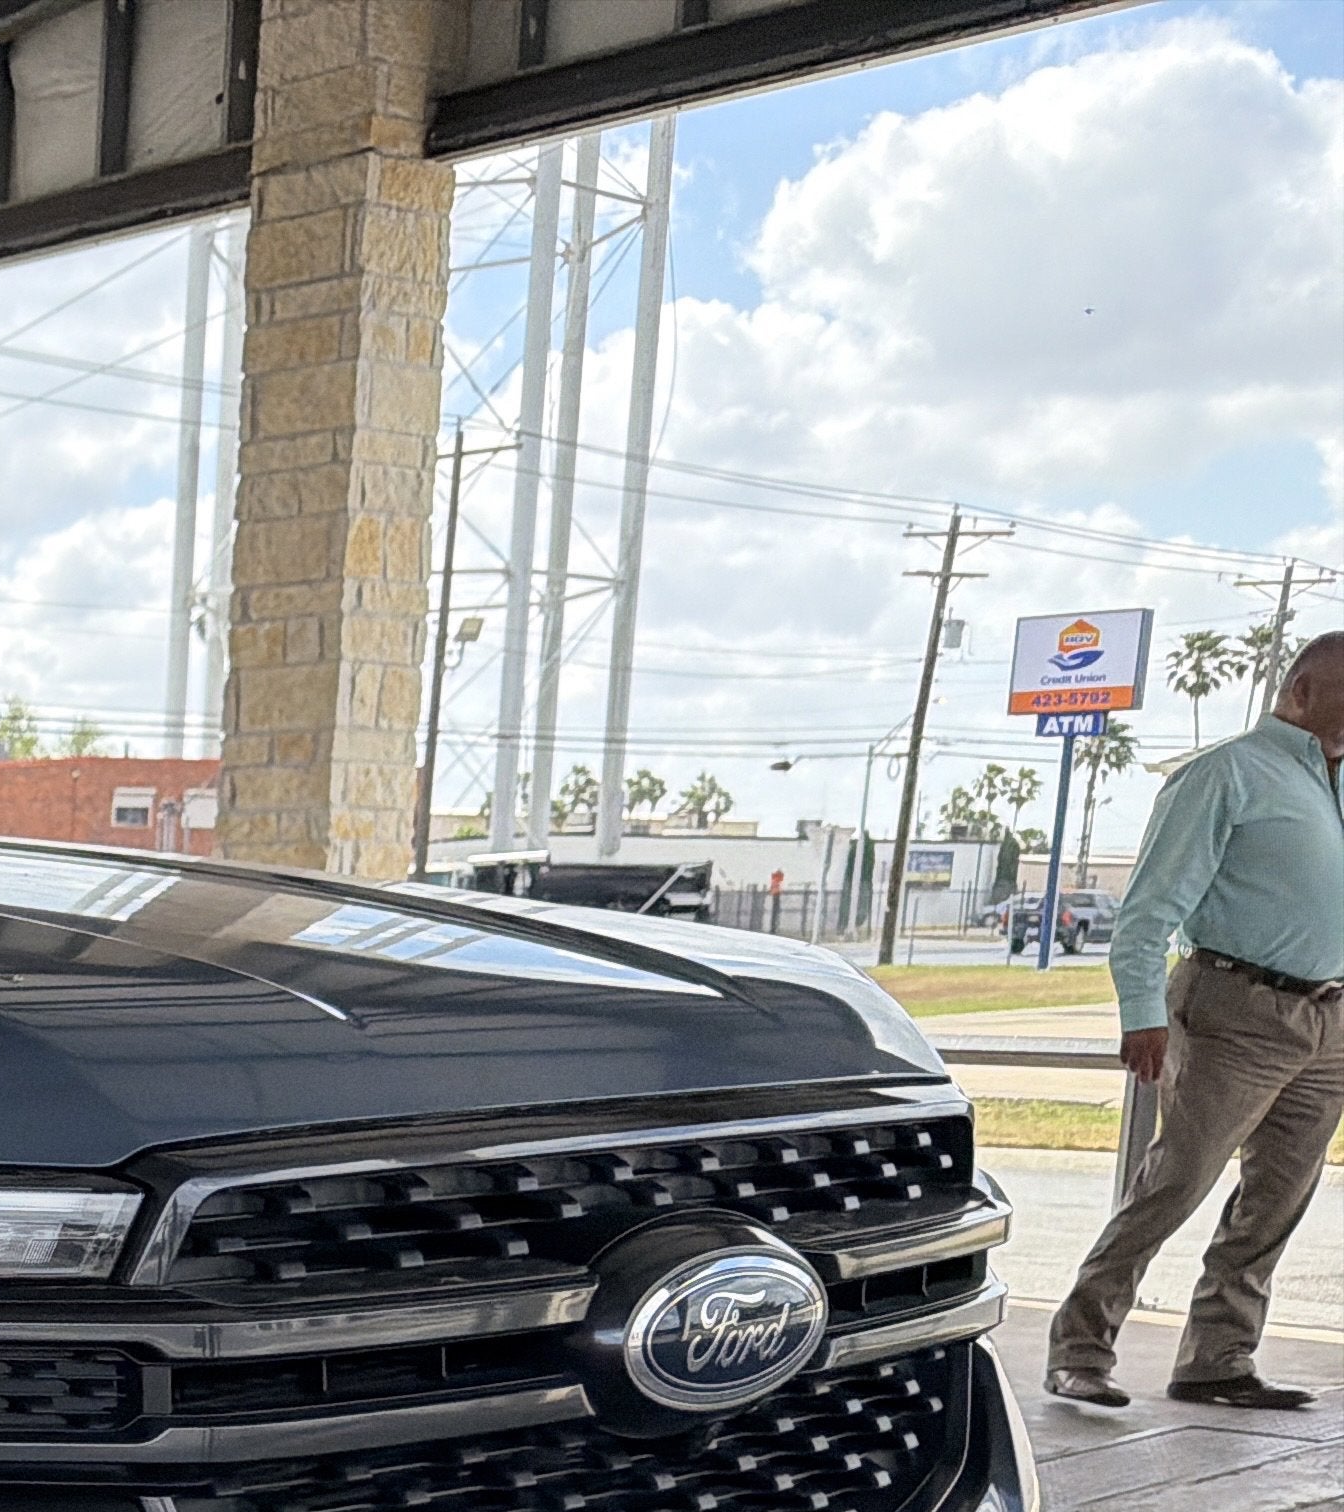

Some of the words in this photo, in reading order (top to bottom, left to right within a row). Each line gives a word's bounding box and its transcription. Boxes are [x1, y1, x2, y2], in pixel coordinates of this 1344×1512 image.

[1040, 675, 1072, 685] Credit
[1075, 673, 1107, 684] Union
[1043, 714, 1094, 733] ATM
[686, 1289, 791, 1373] Ford
